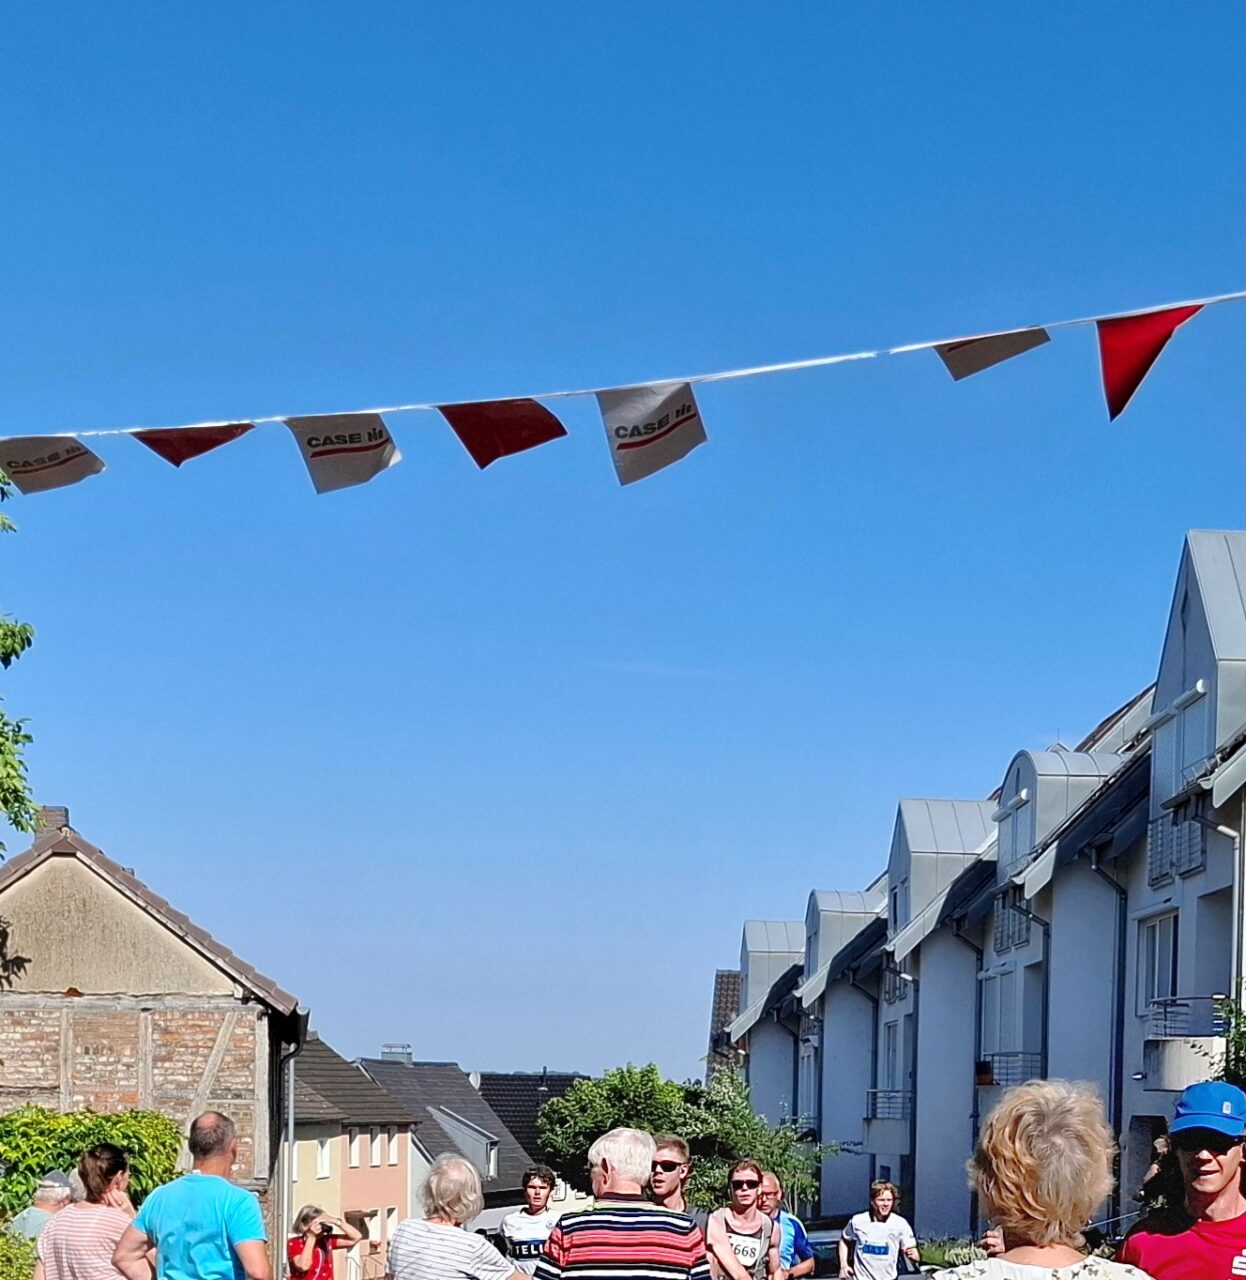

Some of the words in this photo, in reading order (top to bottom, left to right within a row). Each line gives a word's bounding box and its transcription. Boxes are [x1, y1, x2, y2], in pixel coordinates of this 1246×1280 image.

[614, 413, 670, 439] CASE
[306, 432, 361, 448] CASE
[6, 452, 61, 468] CASE
[730, 1243, 757, 1258] 668
